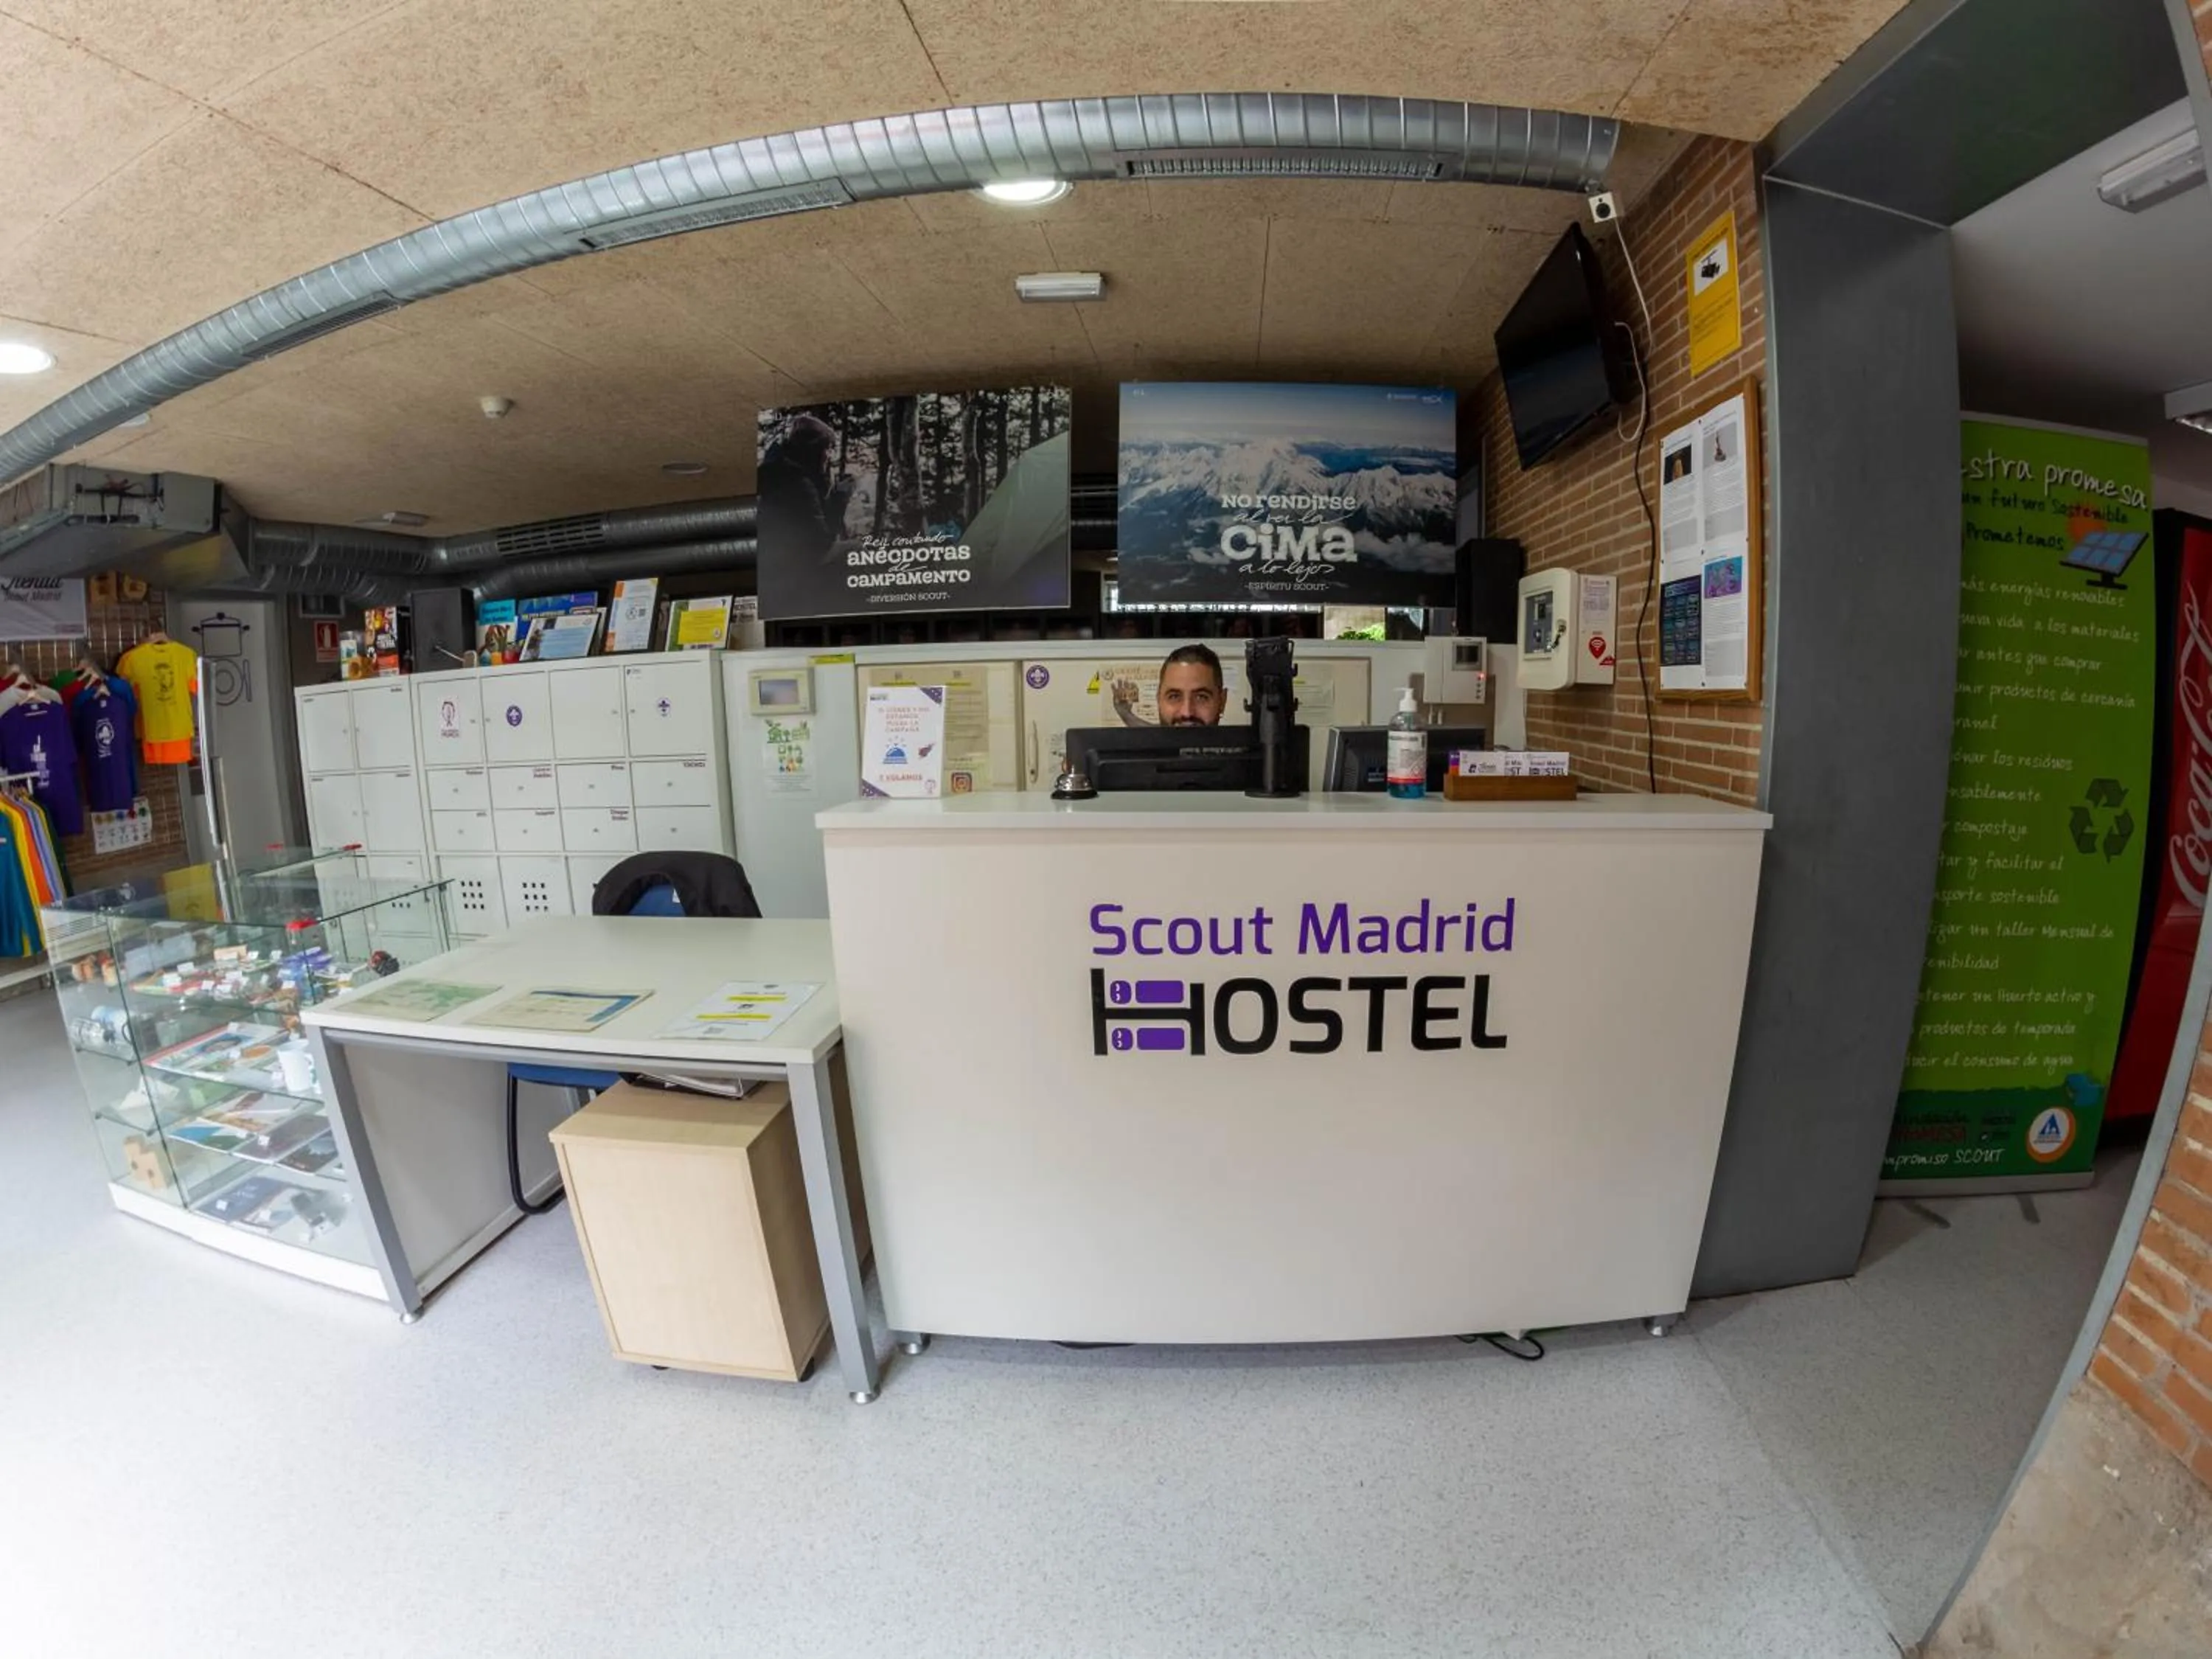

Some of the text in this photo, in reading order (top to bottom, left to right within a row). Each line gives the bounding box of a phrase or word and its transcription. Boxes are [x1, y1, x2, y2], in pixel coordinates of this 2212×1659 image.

[1961, 448, 2147, 509] stra promesa
[1992, 488, 2045, 511] futuro
[2056, 589, 2126, 608] renovables
[1997, 613, 2024, 629] vida
[2048, 617, 2066, 635] los
[2070, 622, 2140, 644] materiales
[1976, 646, 2021, 664] antes
[2054, 655, 2103, 676] comprar
[1990, 682, 2055, 707] productos
[2061, 686, 2077, 703] de
[1952, 713, 1999, 731] ranel
[1994, 748, 2014, 768] los
[2017, 752, 2073, 771] residuos
[1954, 818, 2028, 843] compostaje
[1986, 851, 2044, 871] facilitar
[2049, 855, 2064, 871] el
[1989, 886, 2059, 905] sostenible
[1090, 897, 1516, 956] Scout Madrid
[1997, 920, 2035, 938] taller
[1090, 967, 1508, 1056] HOSTEL
[1919, 1020, 1989, 1039] productos
[2014, 1020, 2077, 1041] temporada
[1943, 1051, 1960, 1067] el
[1963, 1056, 2020, 1068] consumo
[2023, 1051, 2038, 1067] de
[1954, 1147, 2006, 1164] SCOUT
